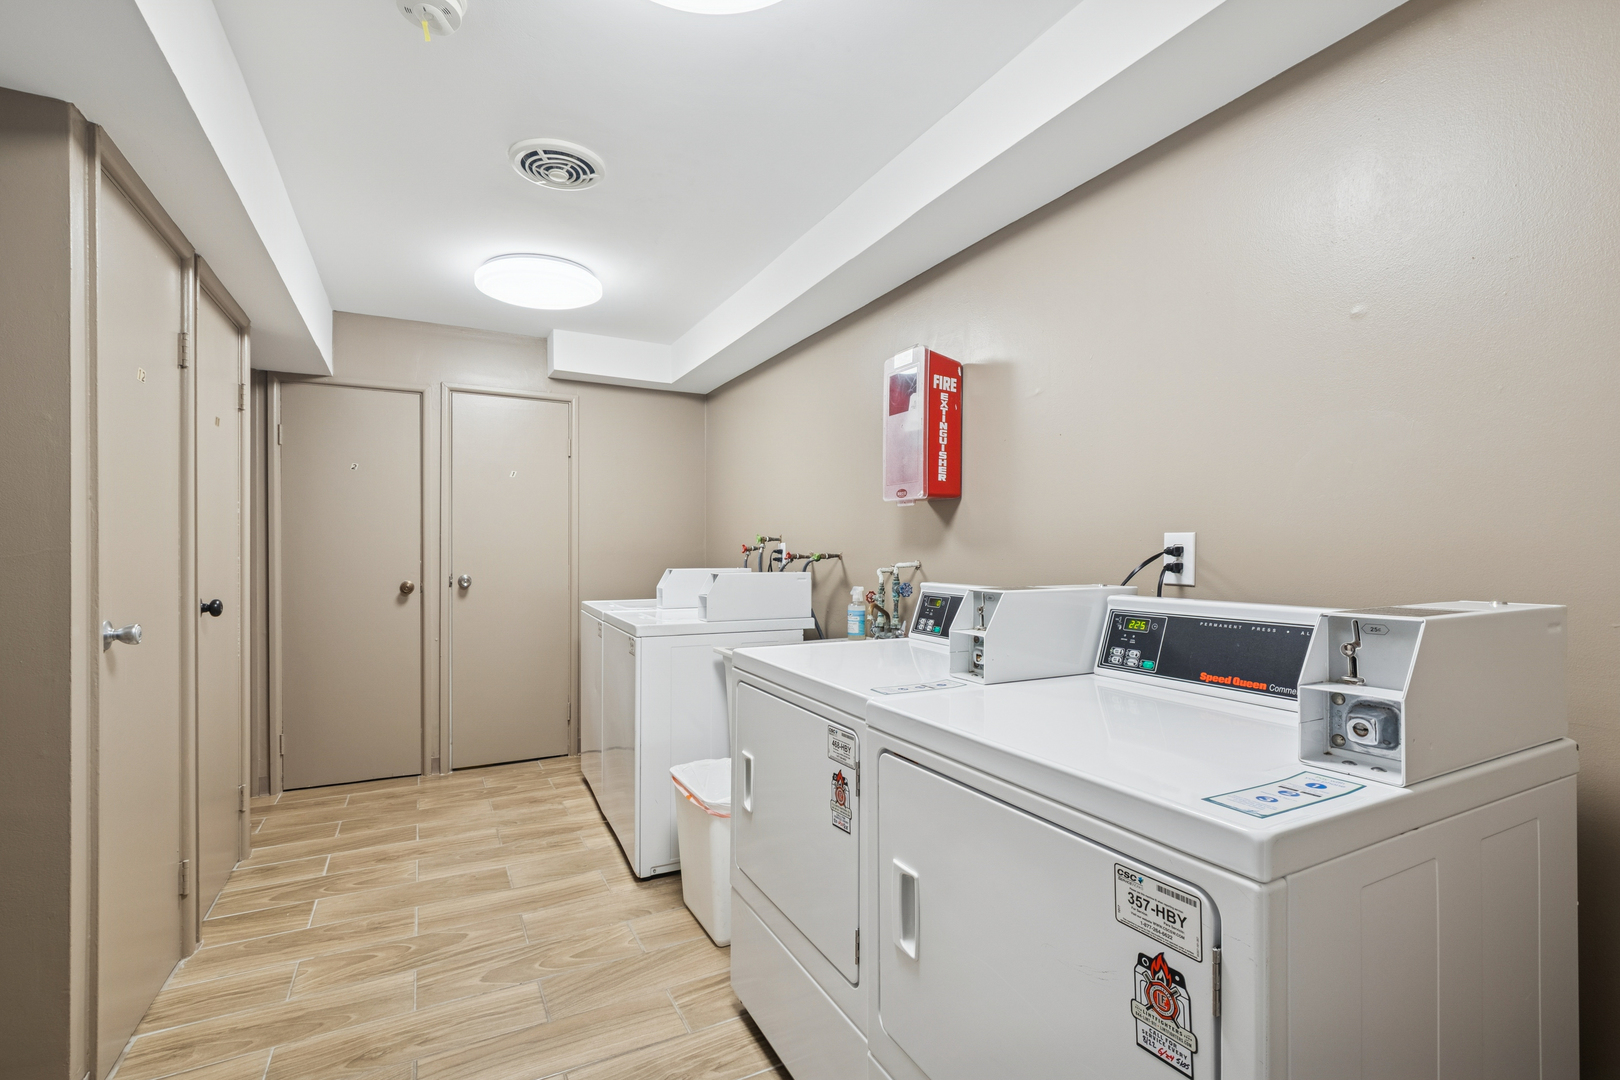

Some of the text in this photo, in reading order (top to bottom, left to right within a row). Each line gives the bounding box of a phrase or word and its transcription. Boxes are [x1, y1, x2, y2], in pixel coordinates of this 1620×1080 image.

[138, 368, 146, 382] 12
[933, 374, 957, 392] FIRE
[938, 393, 949, 482] EXTINGUISHER
[1128, 620, 1146, 630] 225
[1200, 621, 1242, 630] PERMANENT
[1200, 672, 1232, 684] Speed
[1232, 677, 1267, 691] Queen
[1117, 868, 1137, 881] CSC
[1127, 891, 1187, 929] 357-HBY
[1142, 1009, 1183, 1036] LINTFIGHTERS
[1141, 1028, 1188, 1060] SERVICE EVERY
[1149, 1028, 1178, 1049] CALL FOR
